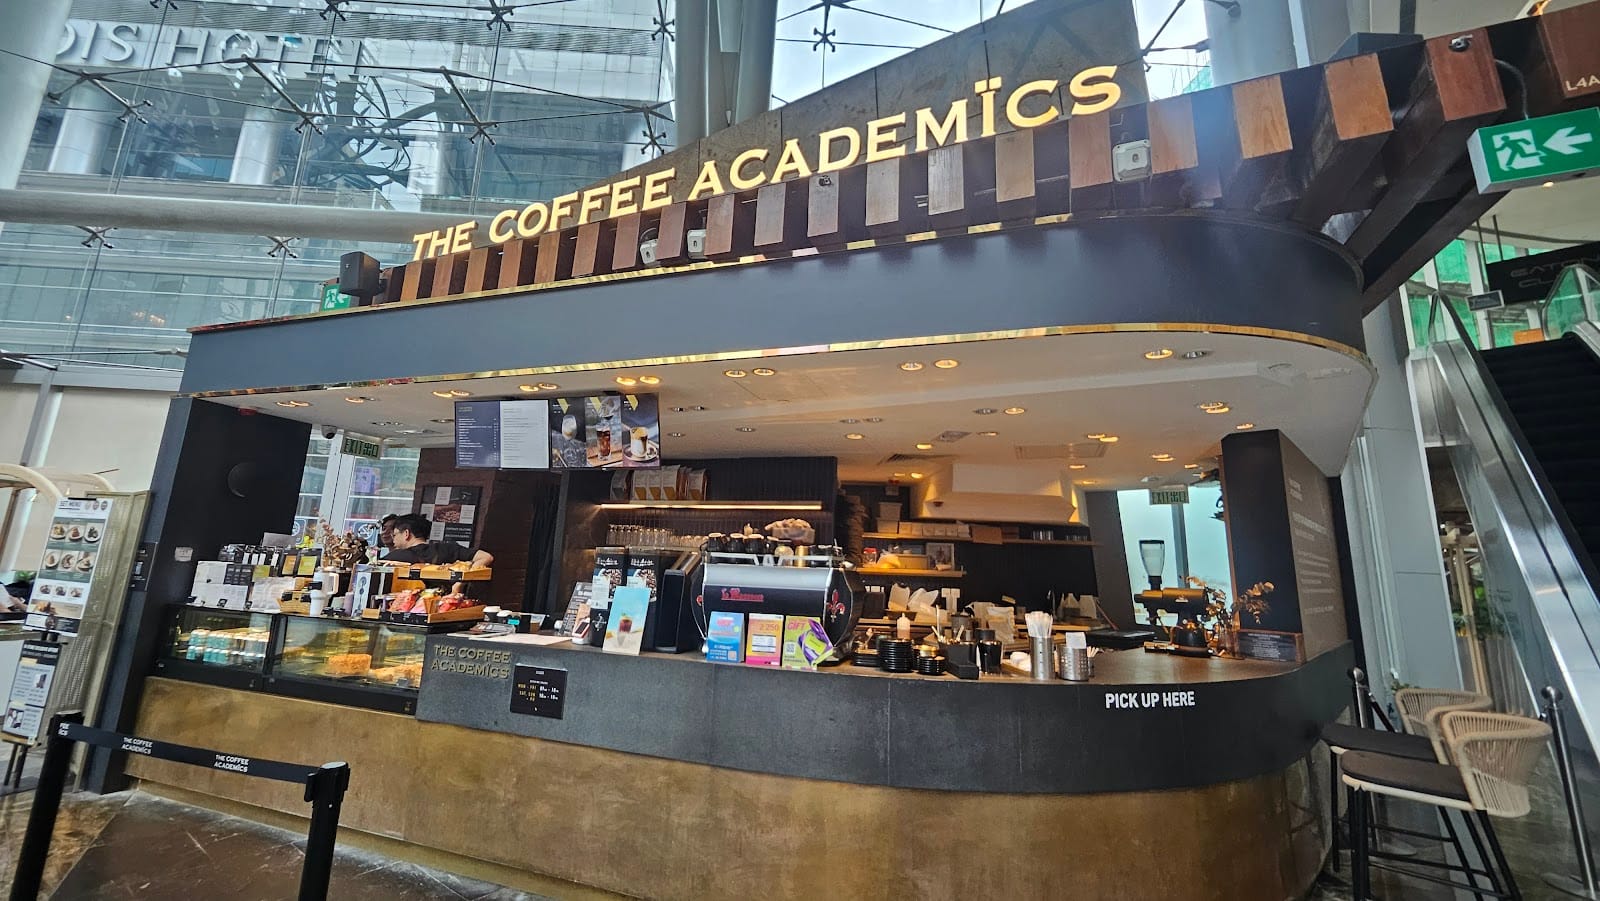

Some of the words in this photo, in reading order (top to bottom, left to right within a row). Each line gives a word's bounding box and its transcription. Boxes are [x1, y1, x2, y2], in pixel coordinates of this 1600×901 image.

[411, 219, 477, 262] THE
[488, 166, 676, 244] COFFEE
[344, 436, 364, 455] EXIT
[787, 620, 808, 631] GIFT
[433, 644, 456, 658] THE
[458, 647, 512, 664] COFFEE
[1105, 692, 1140, 709] PICK
[1141, 692, 1160, 708] UP
[1162, 690, 1196, 707] HERE
[123, 736, 133, 744] THE
[133, 738, 153, 748] COFFEE
[215, 754, 226, 762] THE
[226, 755, 249, 766] COFFEE
